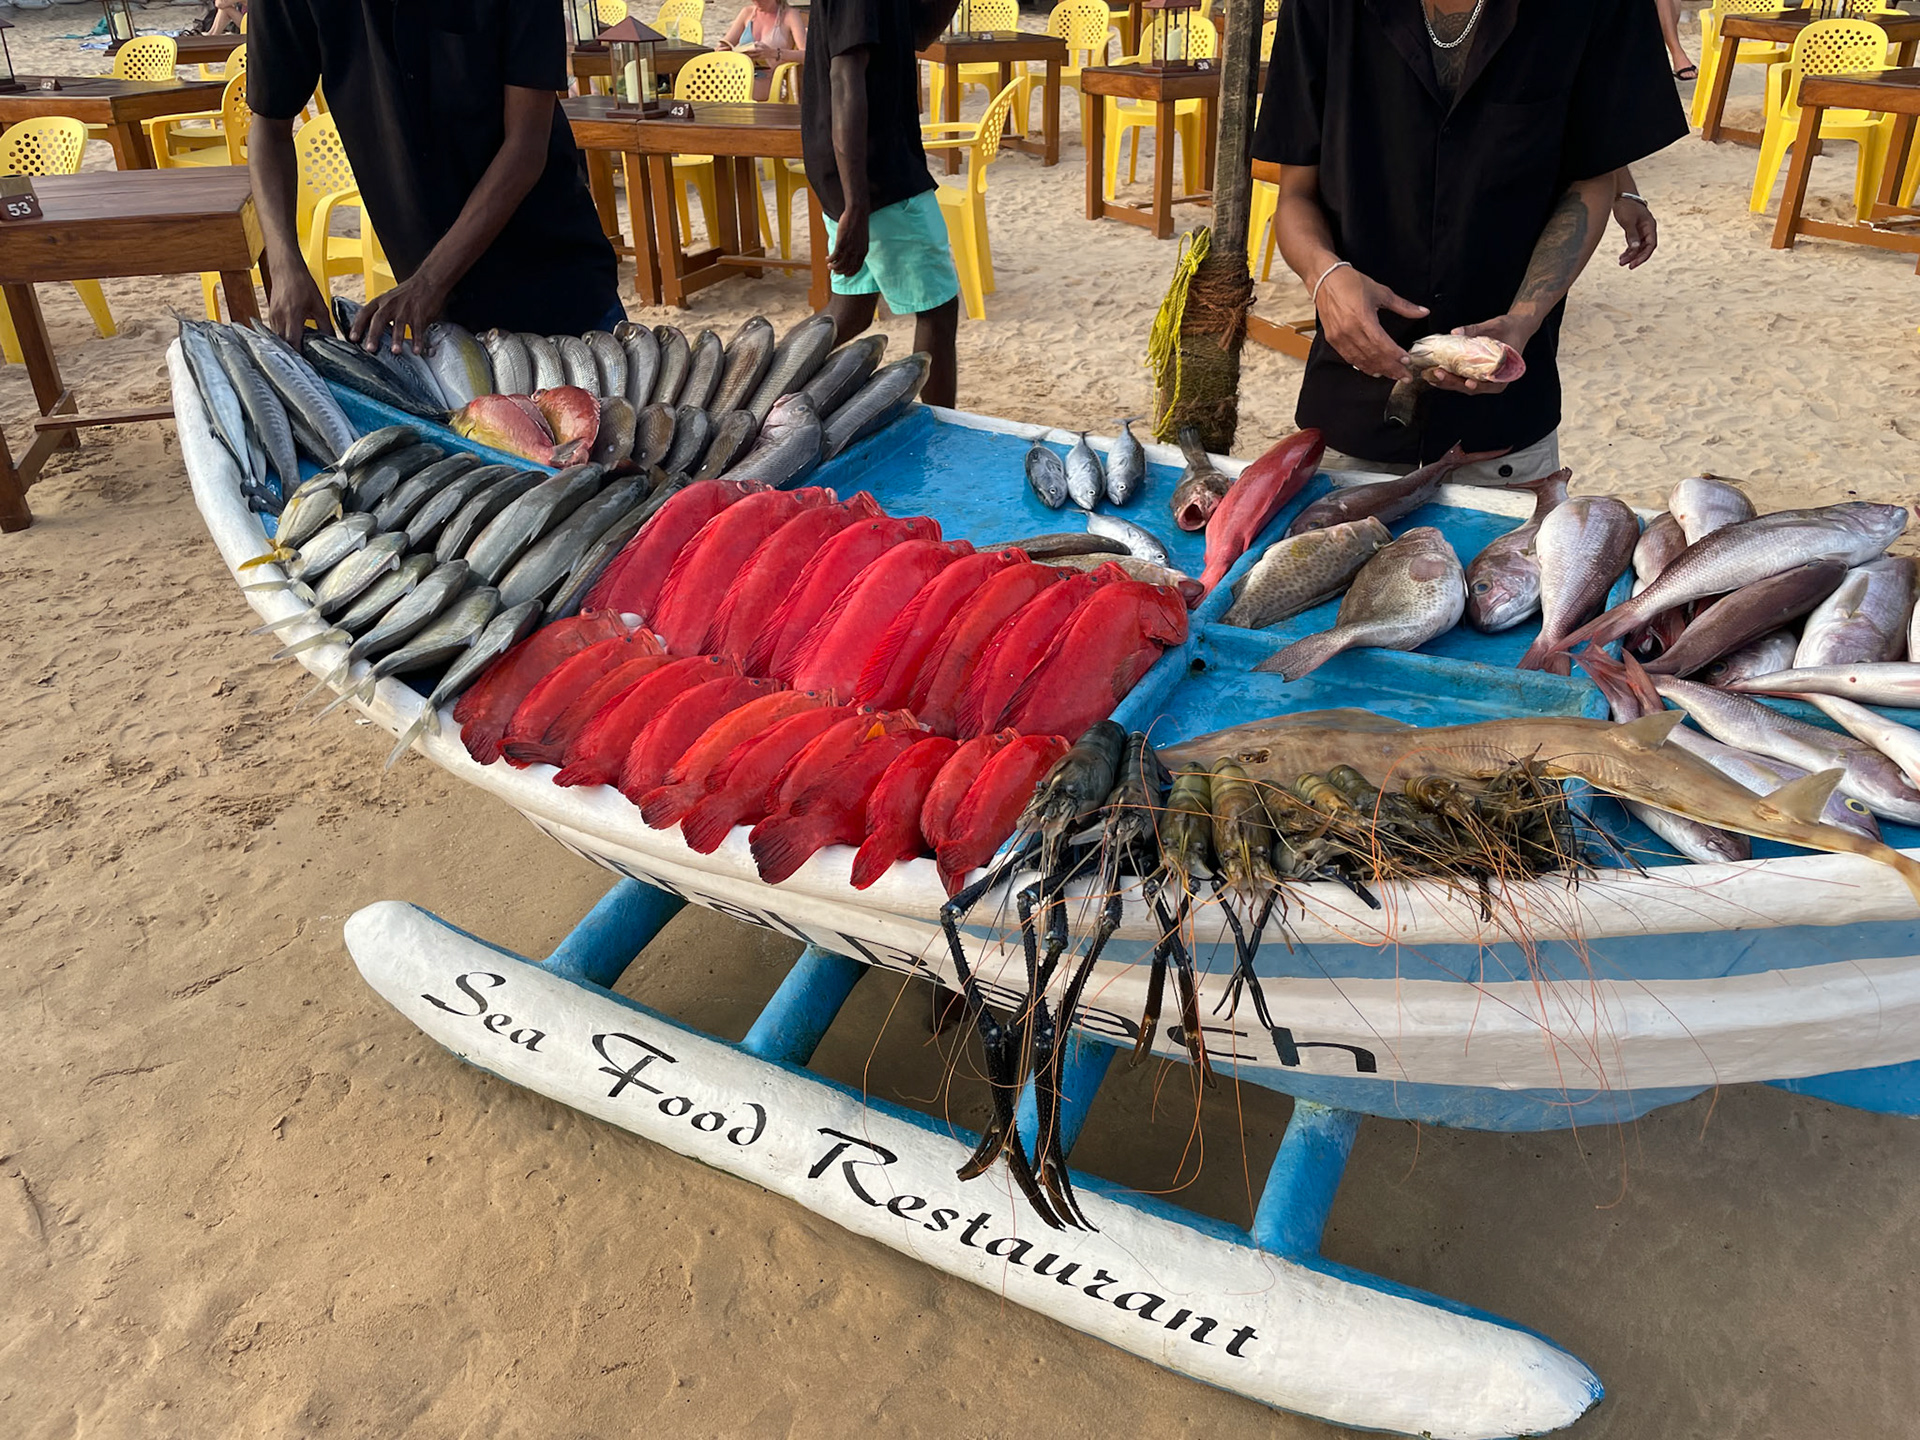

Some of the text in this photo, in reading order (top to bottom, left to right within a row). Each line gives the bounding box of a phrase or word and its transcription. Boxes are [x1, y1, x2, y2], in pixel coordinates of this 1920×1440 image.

[671, 106, 684, 116] 43
[7, 201, 32, 217] 53
[421, 972, 1258, 1357] Sea Food Restaurant
